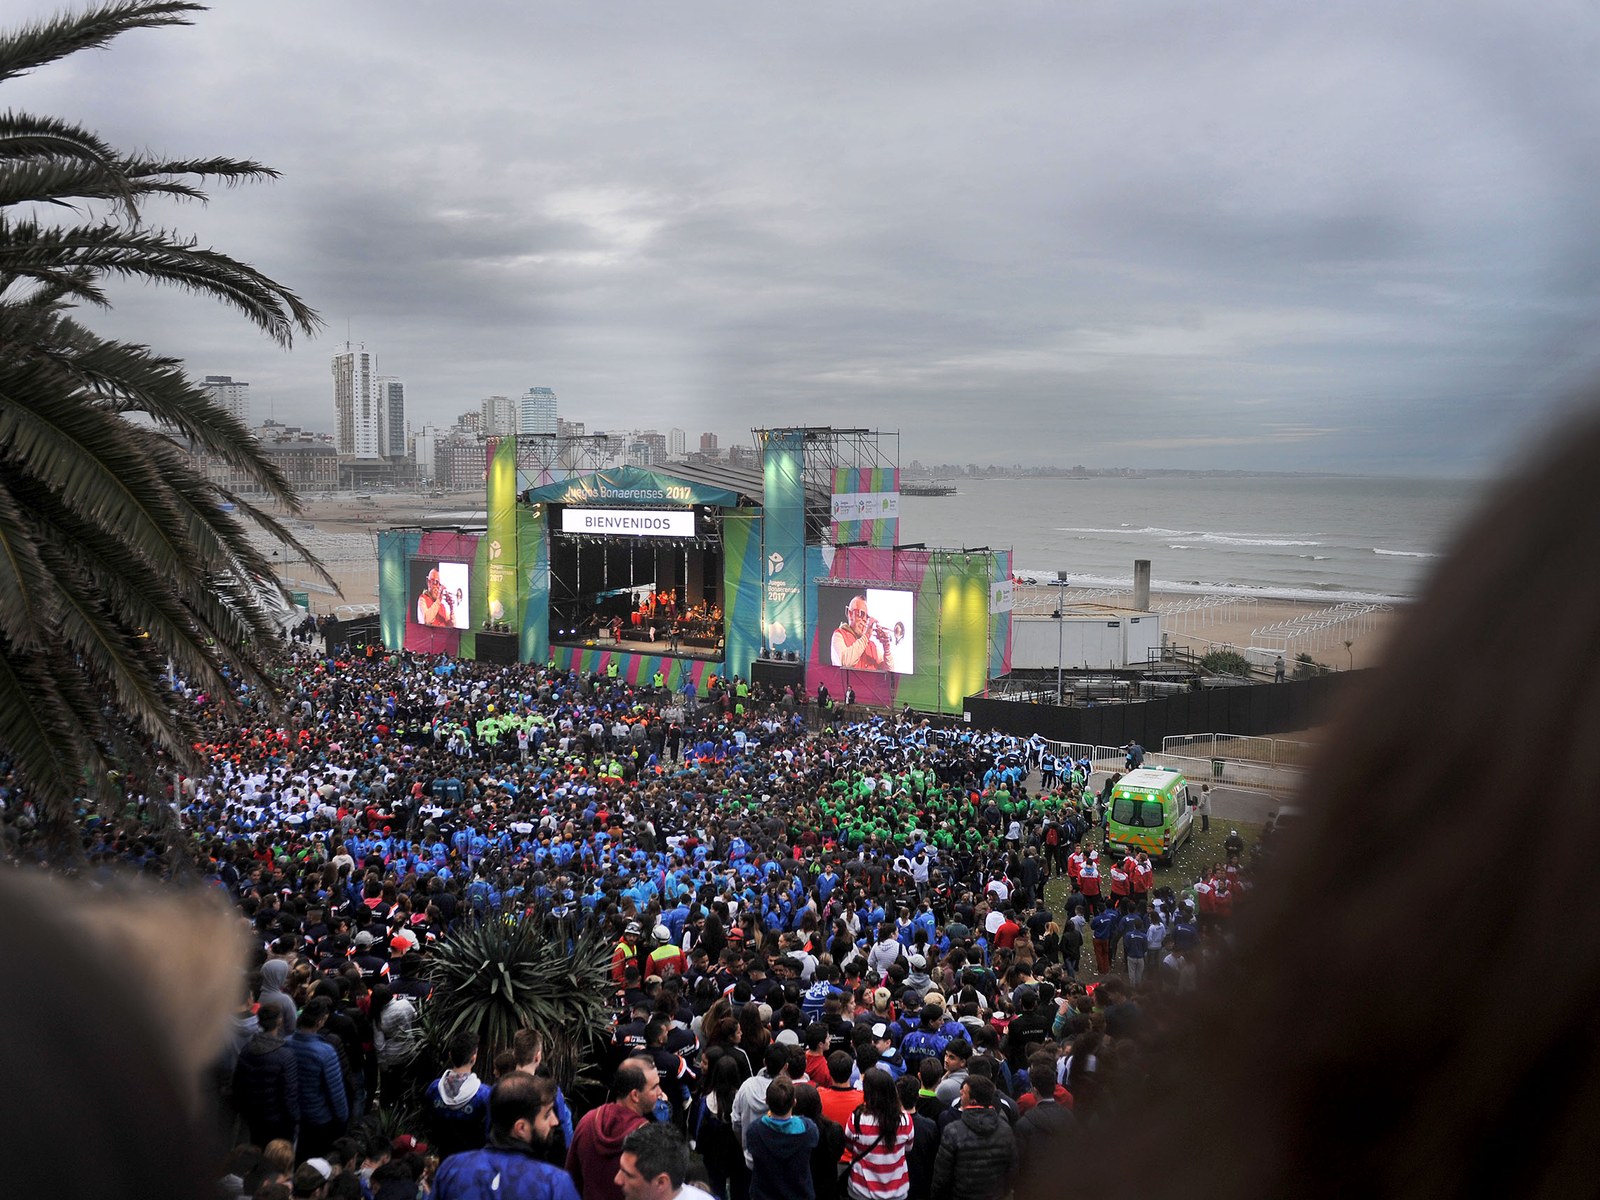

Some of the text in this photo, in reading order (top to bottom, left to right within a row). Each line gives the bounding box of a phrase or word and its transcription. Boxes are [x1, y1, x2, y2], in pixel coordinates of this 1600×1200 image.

[565, 486, 692, 500] Juegos Bonaerenses 2017
[585, 516, 671, 530] BIENVENIDOS
[768, 592, 786, 601] 2017
[1119, 785, 1160, 796] AMBULANCIA
